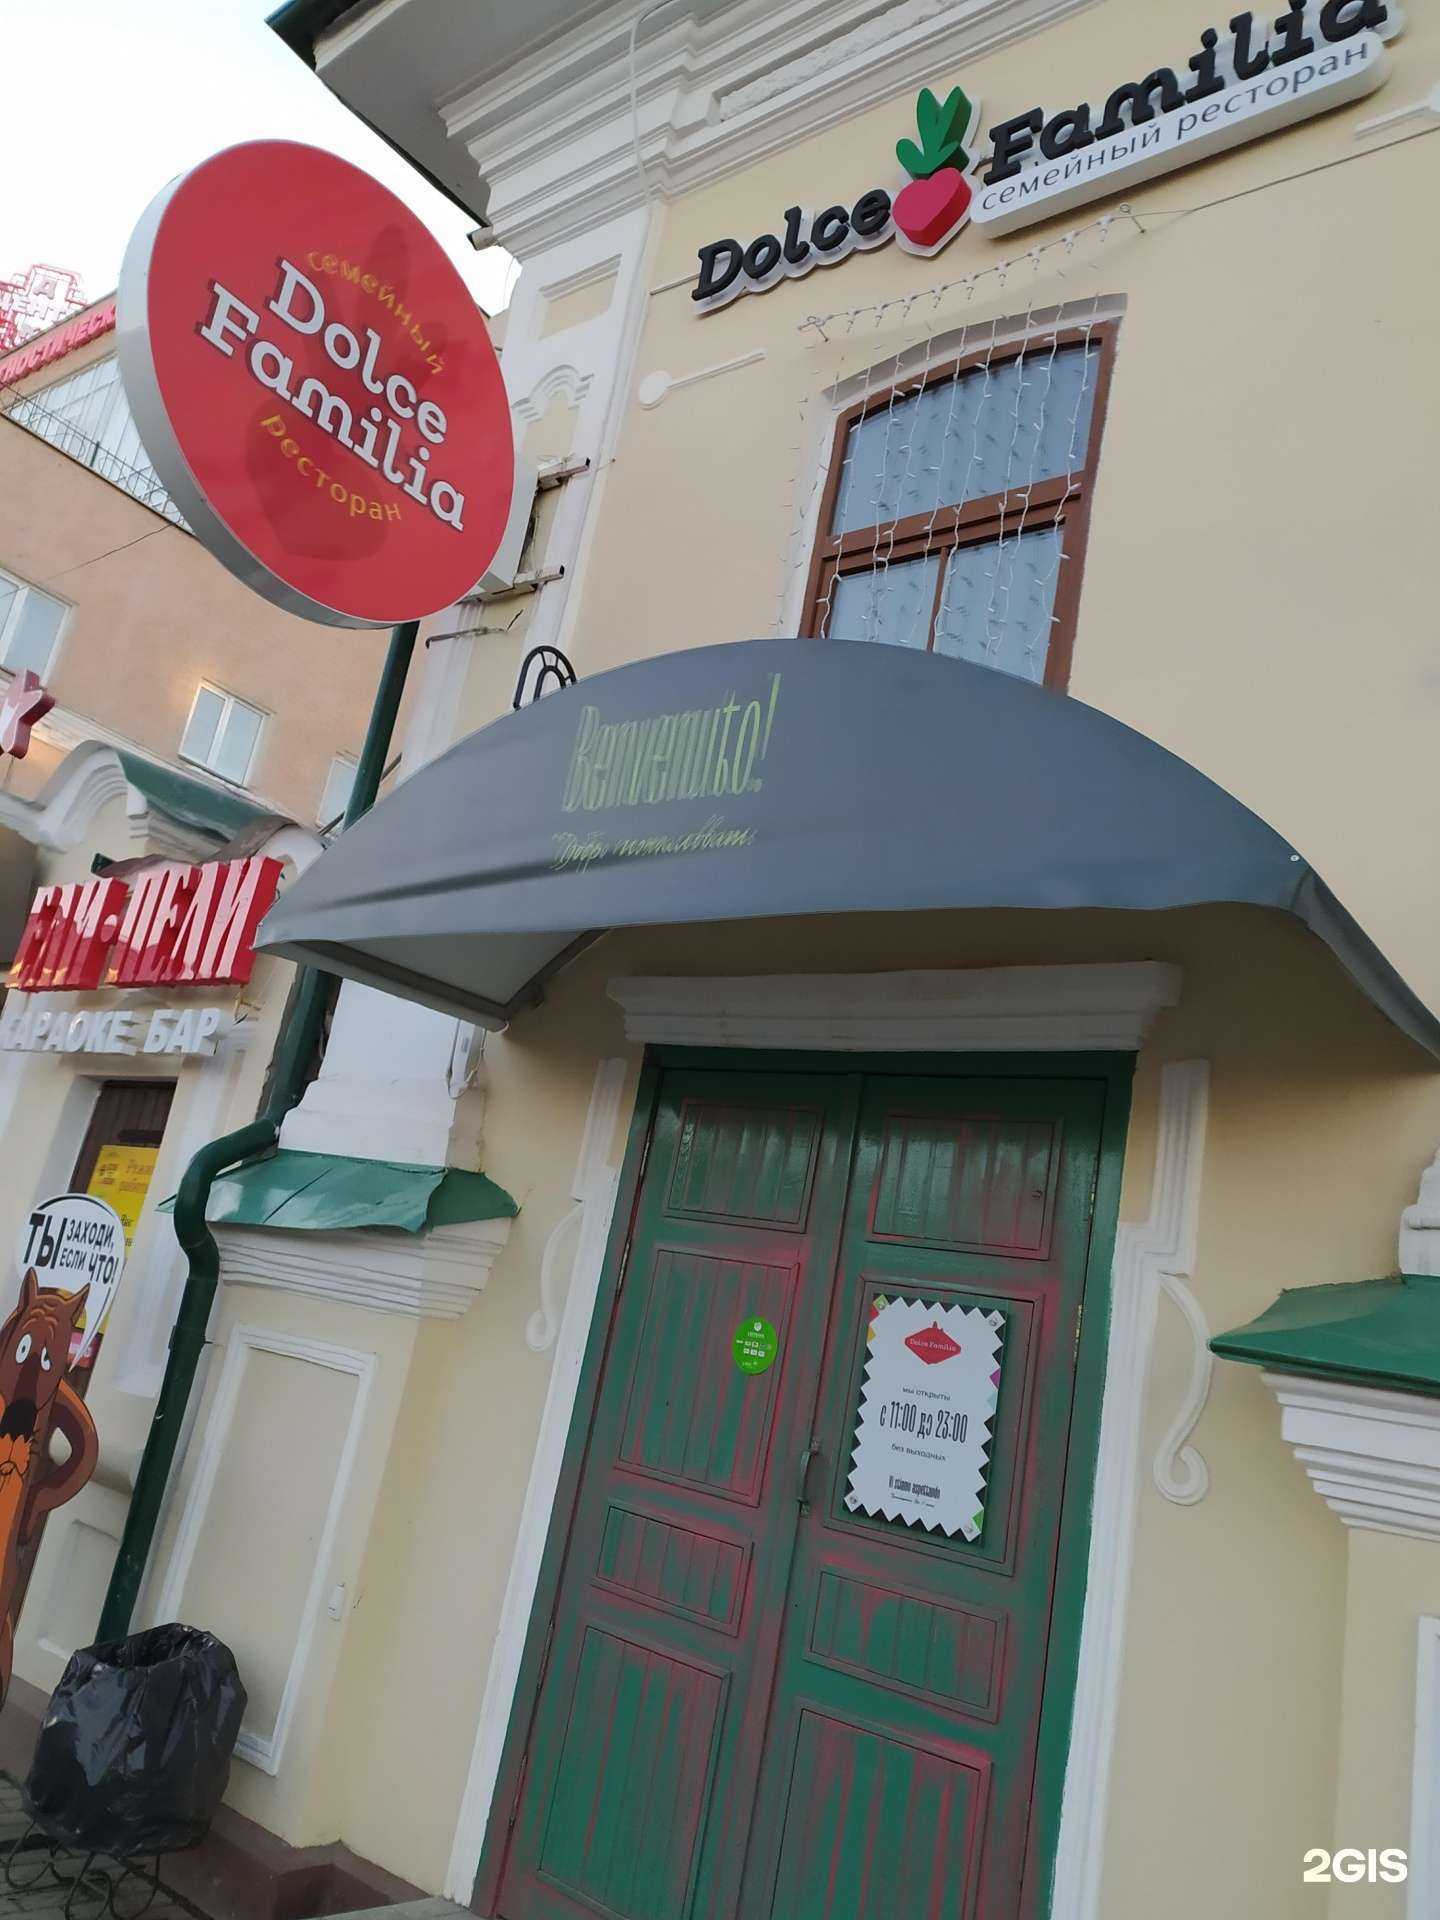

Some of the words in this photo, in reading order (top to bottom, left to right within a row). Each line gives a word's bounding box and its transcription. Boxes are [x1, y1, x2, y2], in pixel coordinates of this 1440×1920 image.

[692, 187, 892, 301] Dolce
[984, 0, 1388, 185] Familia
[982, 122, 1161, 213] семейный
[1176, 40, 1369, 142] ресторан
[267, 257, 448, 444] Dolce
[307, 251, 444, 375] семейный
[199, 281, 465, 532] Familia
[260, 414, 402, 521] ресторан
[143, 1008, 221, 1055] БАР
[23, 1212, 68, 1270] ТЫ
[66, 1219, 116, 1252] ЗАХОДИ,
[59, 1248, 87, 1271] ЕСЛИ
[88, 1253, 119, 1285] ЧТО!
[889, 1400, 918, 1433] 11:00
[935, 1409, 968, 1444] 23:00
